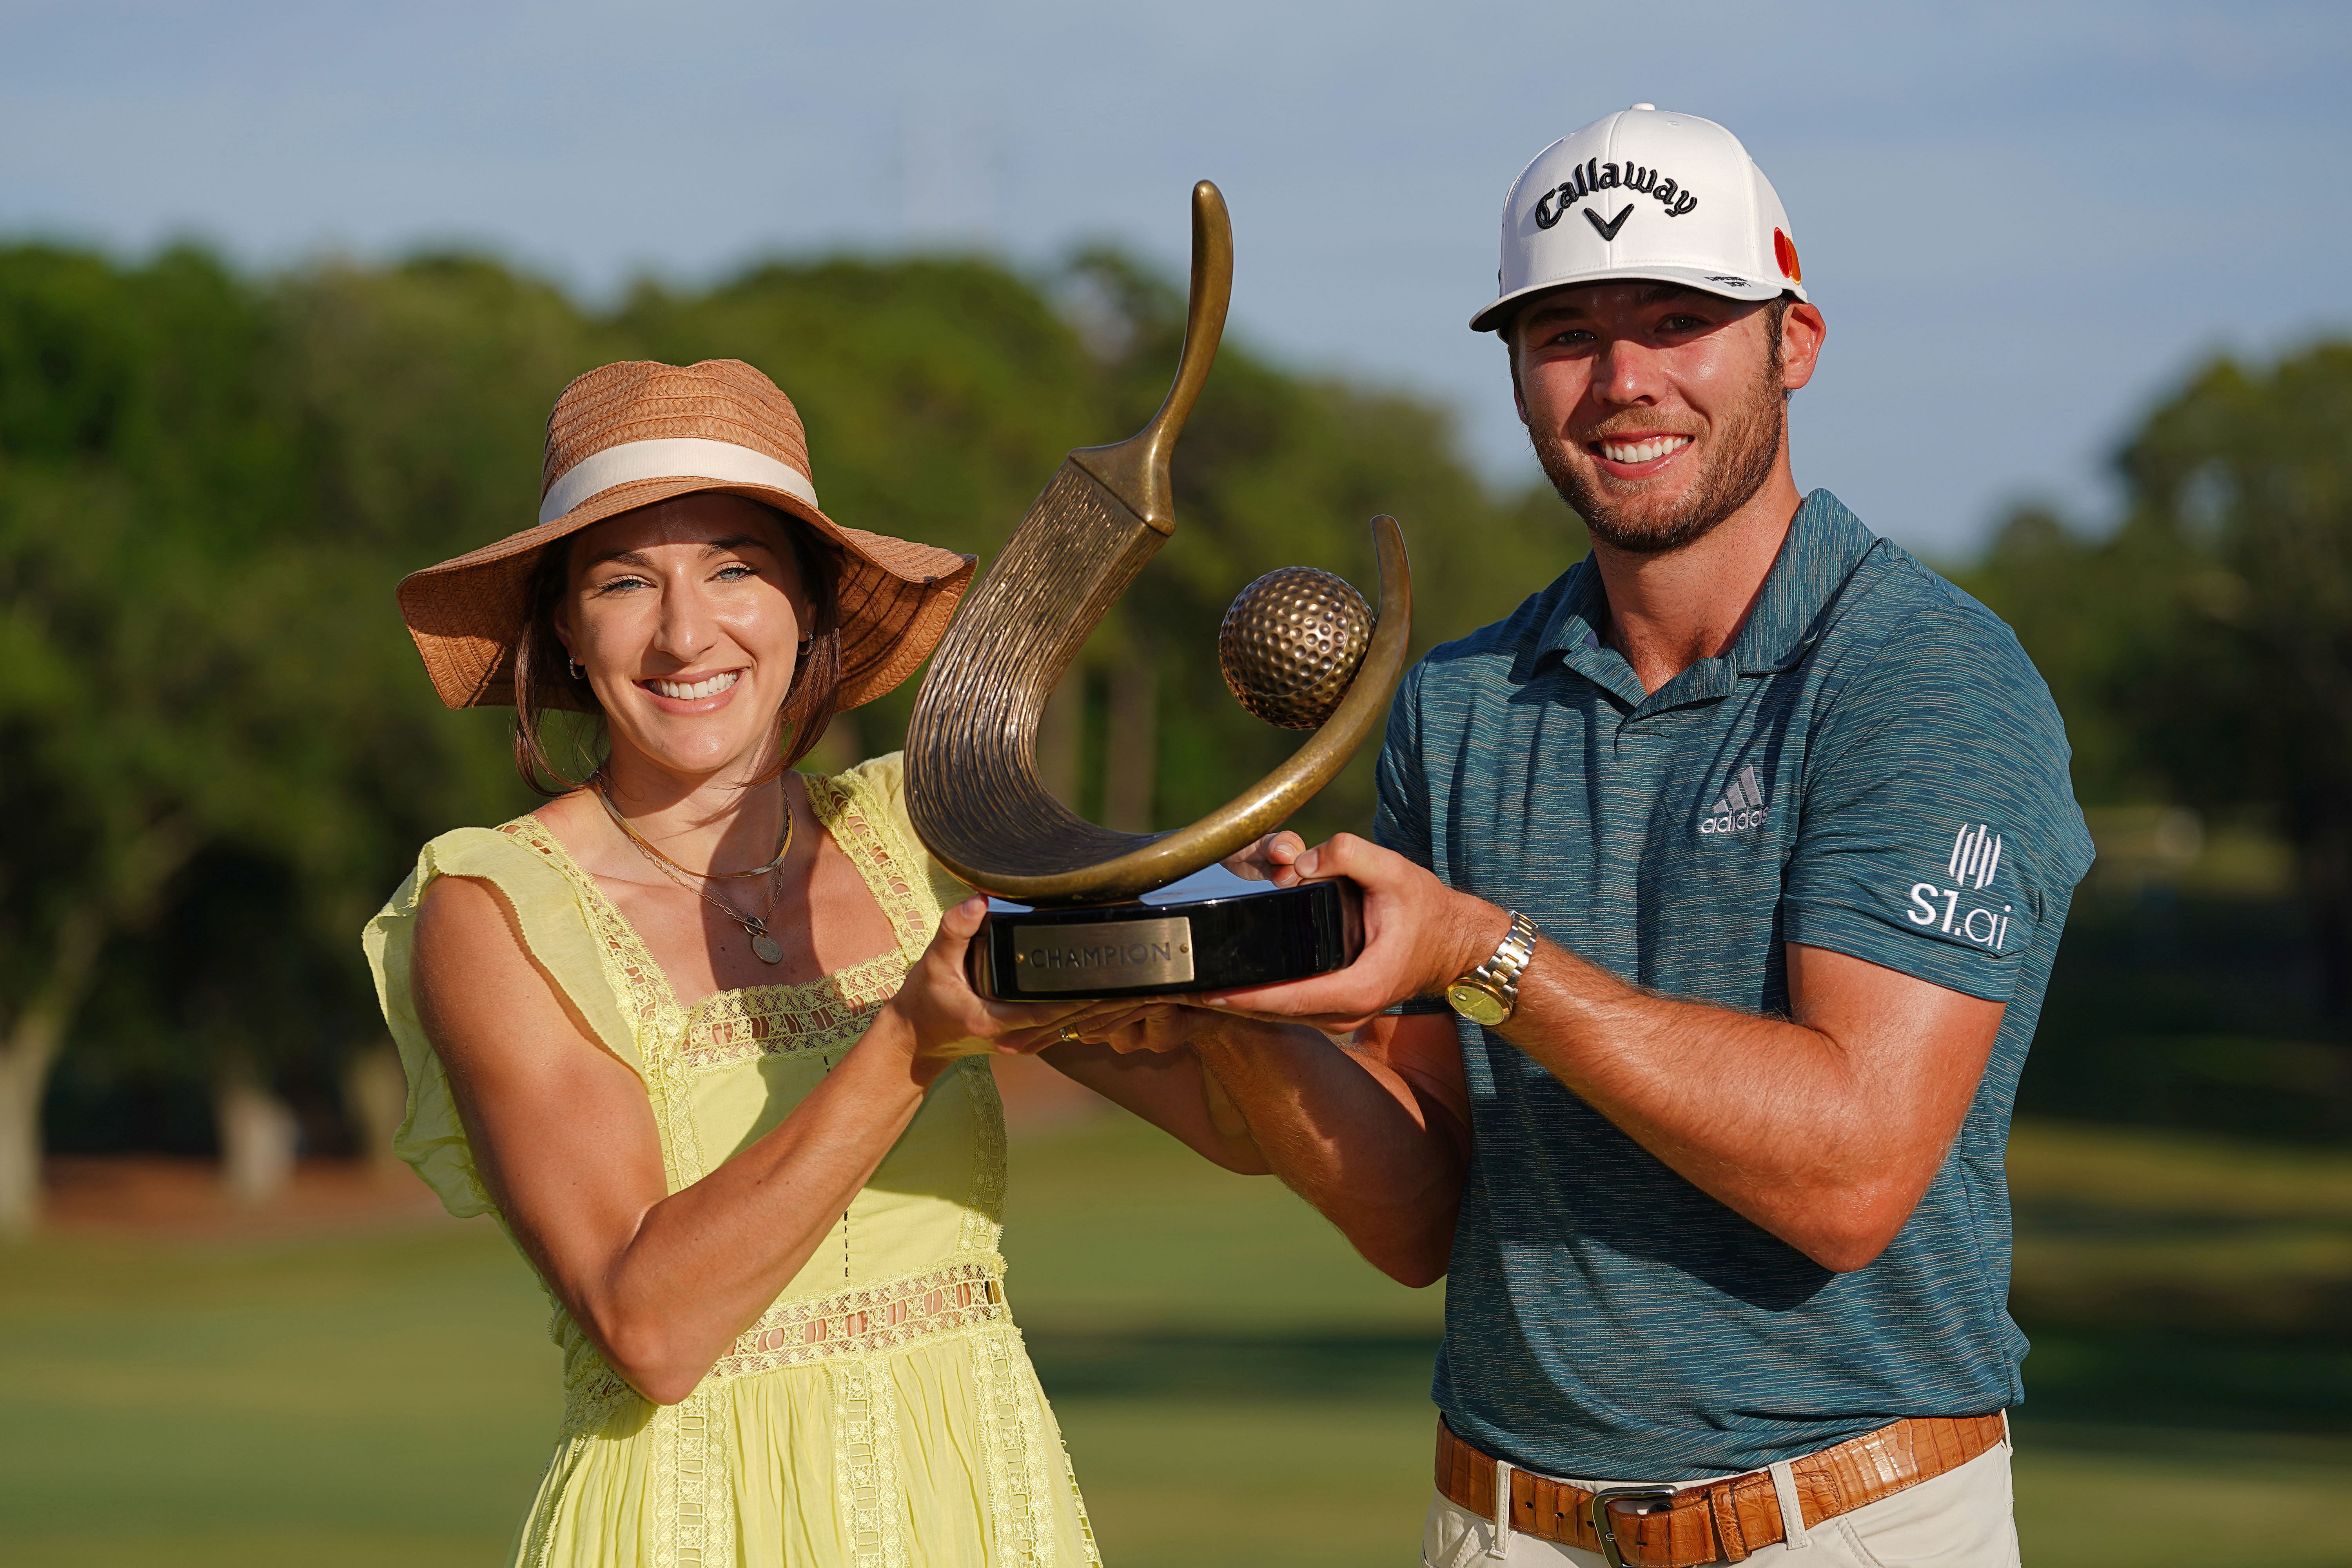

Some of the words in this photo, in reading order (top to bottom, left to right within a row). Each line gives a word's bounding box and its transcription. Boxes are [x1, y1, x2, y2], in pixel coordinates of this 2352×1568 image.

[1535, 157, 1697, 229] Callaway
[1700, 806, 1769, 833] adidas
[1907, 883, 2011, 949] S1.ai
[1029, 942, 1171, 969] CHAMPION
